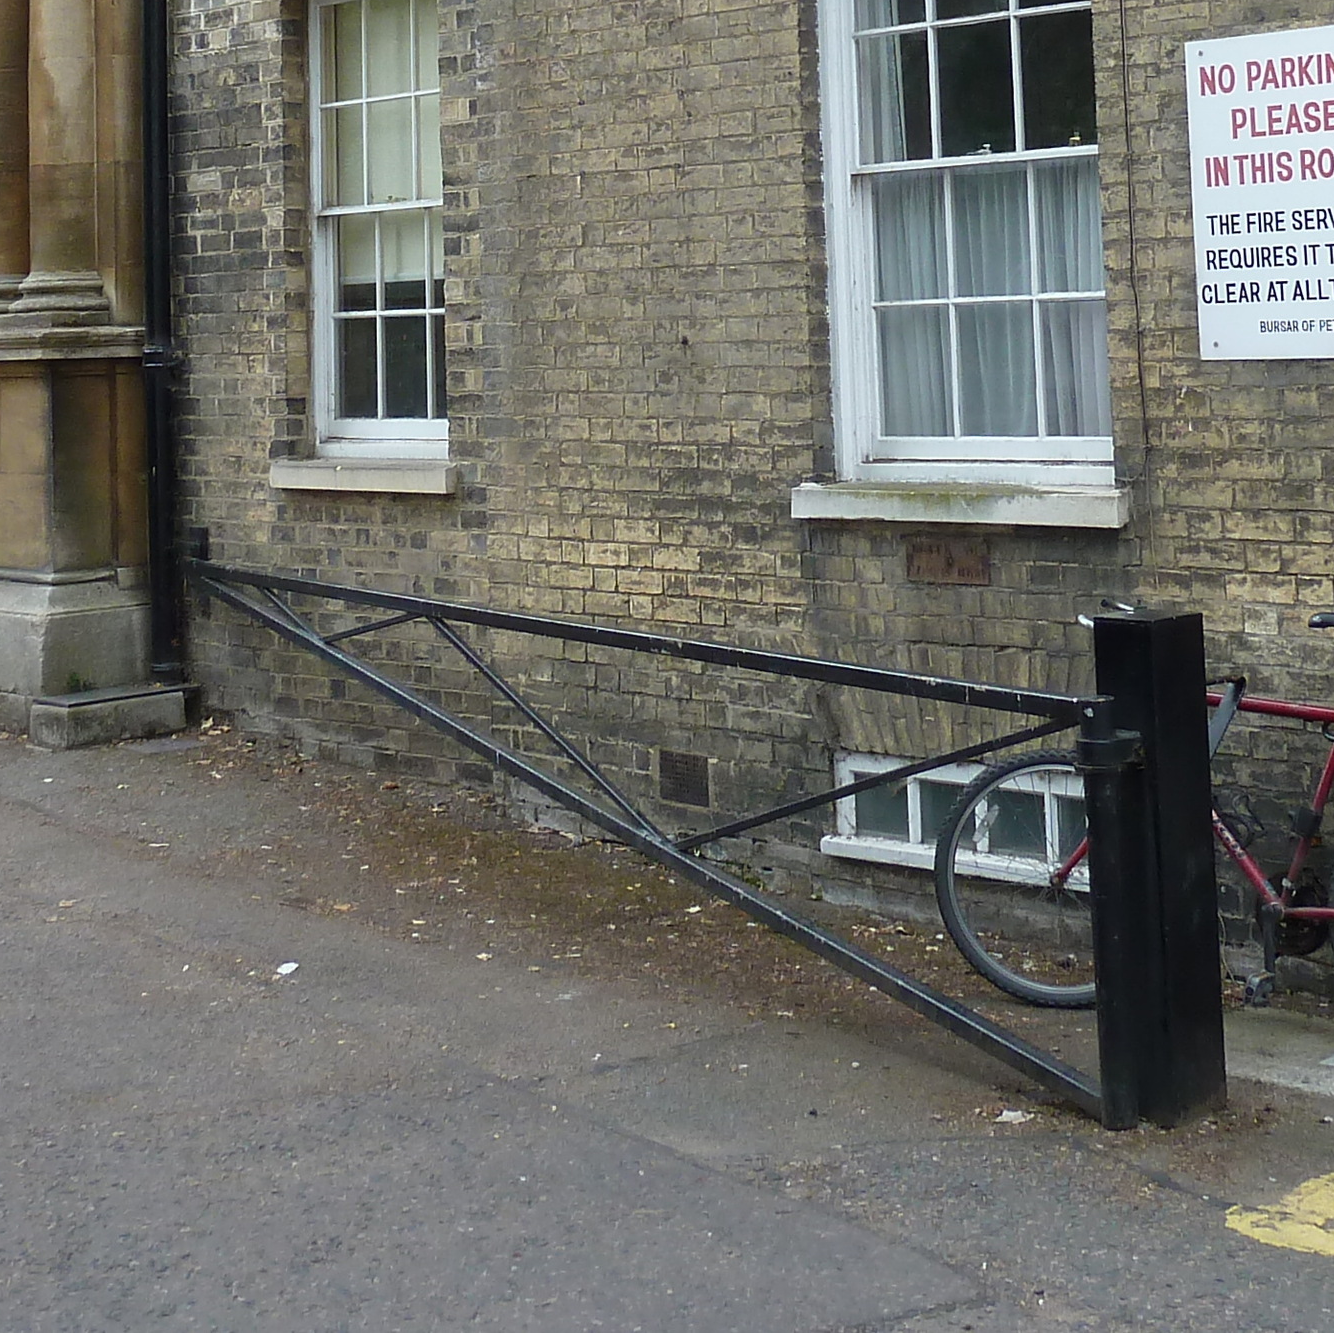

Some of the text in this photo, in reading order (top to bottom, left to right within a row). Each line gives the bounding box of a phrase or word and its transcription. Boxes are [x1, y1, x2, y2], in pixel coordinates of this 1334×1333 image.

[1199, 64, 1236, 96] NO
[1205, 157, 1230, 187] IN
[1233, 151, 1293, 185] THIS
[1206, 214, 1241, 236] THE
[1247, 211, 1286, 234] FIRE
[1206, 246, 1297, 271] REQUIRES
[1303, 244, 1321, 266] IT
[1202, 282, 1261, 305] CLEAR
[1267, 281, 1288, 303] AT
[1292, 279, 1329, 301] ALL
[1259, 320, 1300, 334] BURSAR
[1302, 319, 1316, 333] OF
